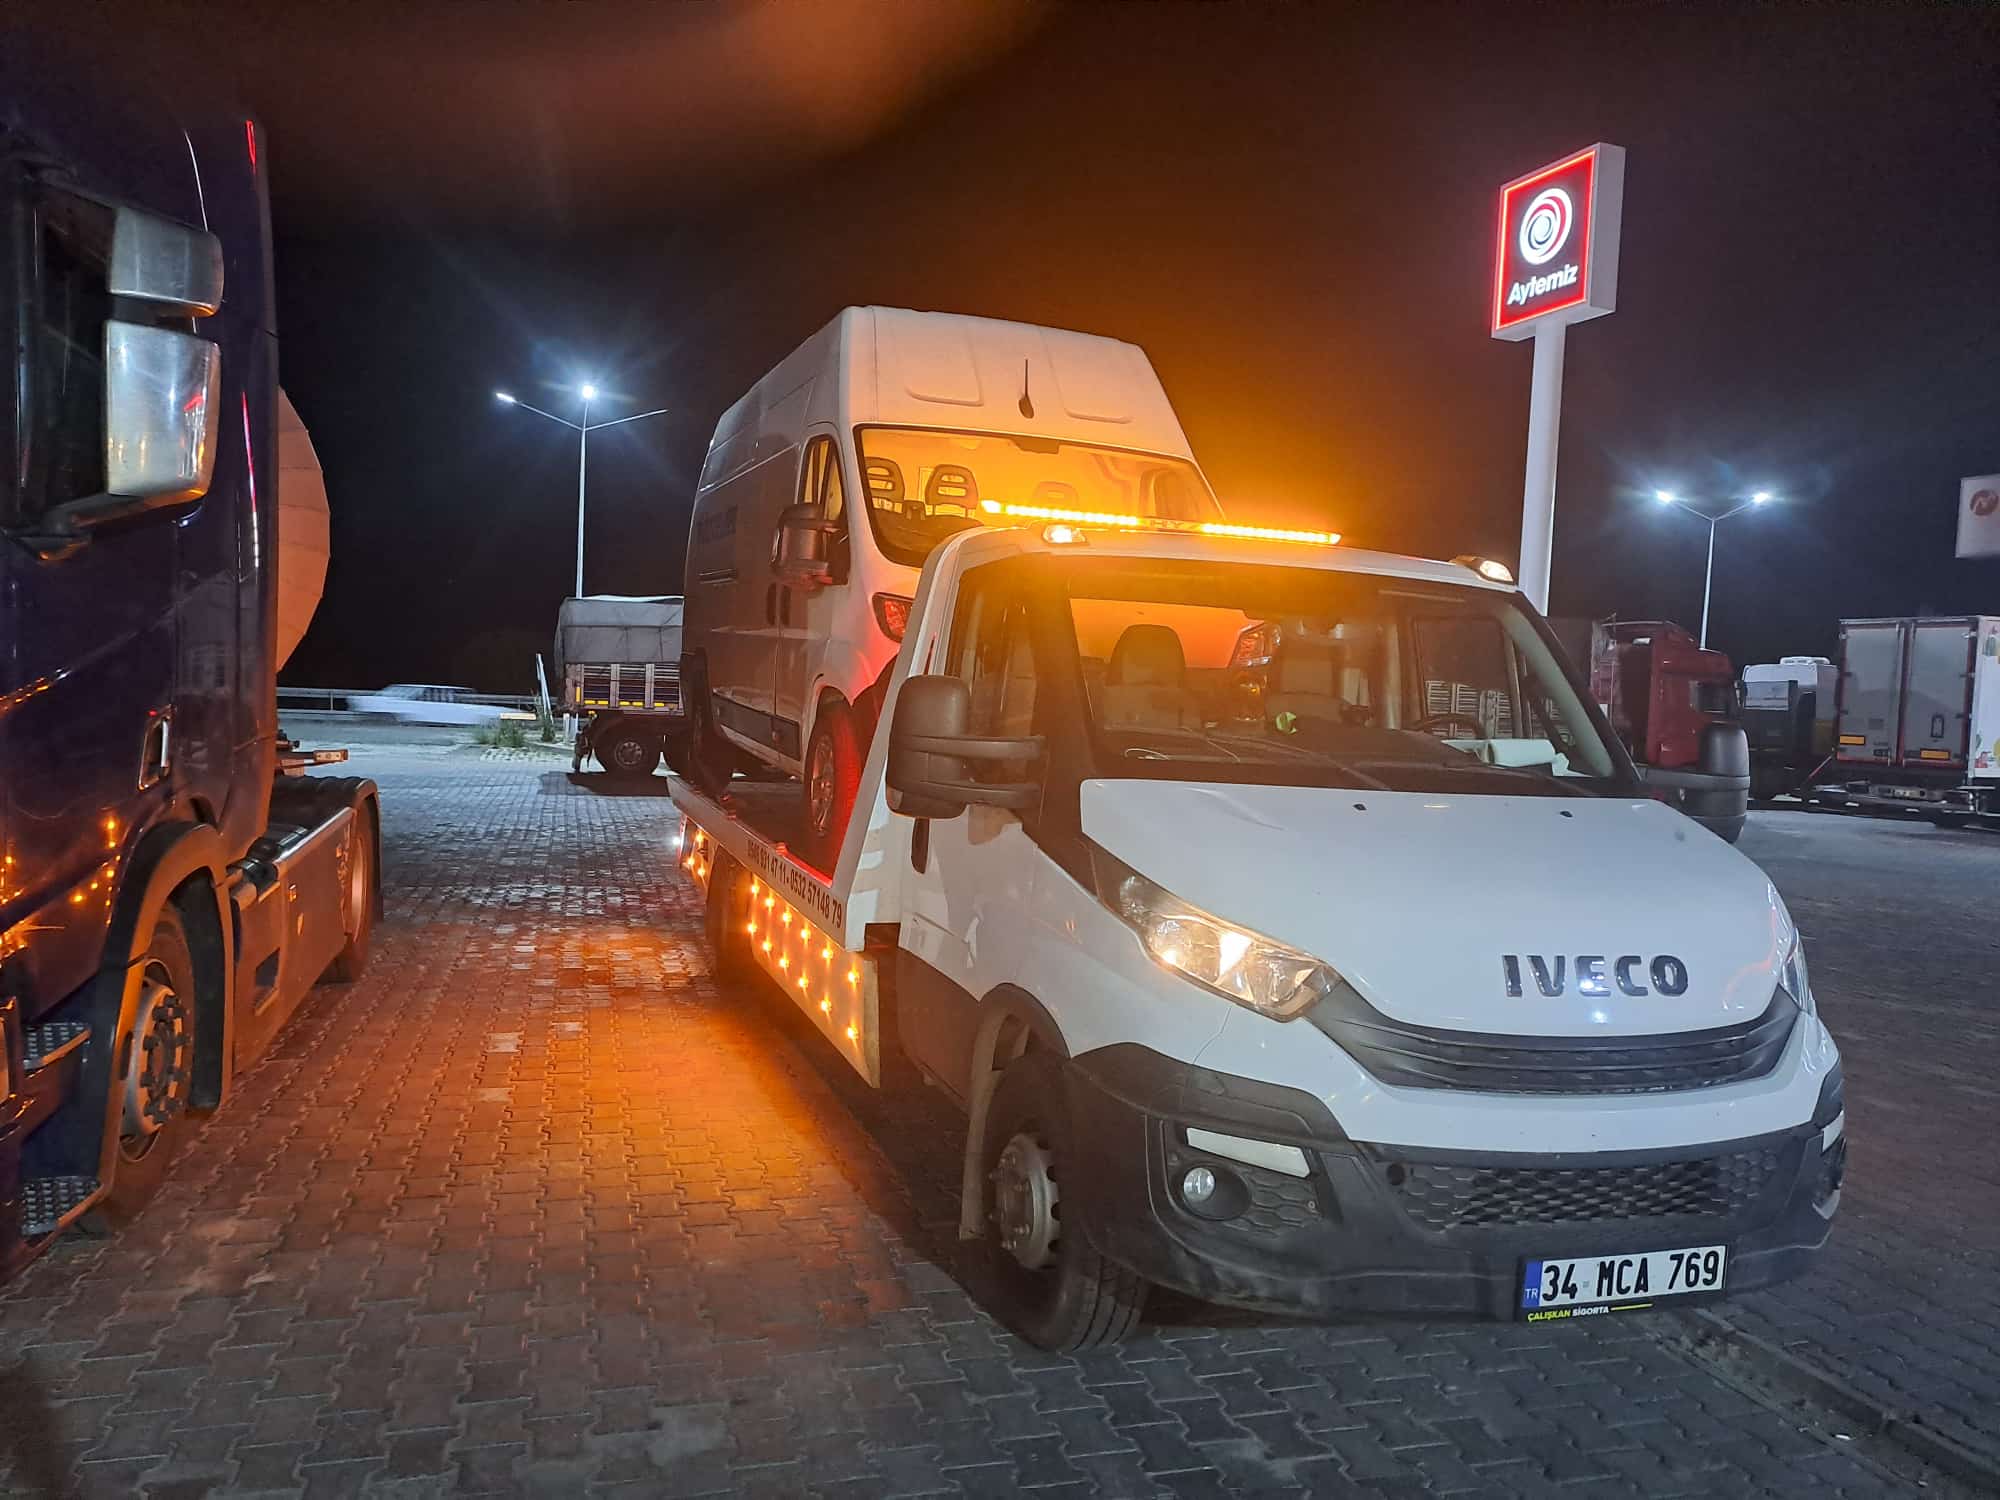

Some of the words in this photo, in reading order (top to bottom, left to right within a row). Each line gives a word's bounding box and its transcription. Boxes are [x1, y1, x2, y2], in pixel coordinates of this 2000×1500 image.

[1507, 264, 1578, 305] Aytemiz
[831, 899, 843, 928] 79
[1502, 955, 1688, 998] IVECO
[1525, 1288, 1538, 1299] TR
[1542, 1264, 1578, 1302] 34
[1596, 1258, 1649, 1298] MCA
[1668, 1250, 1720, 1290] 769
[1527, 1309, 1571, 1322] ÇALIŞKAN
